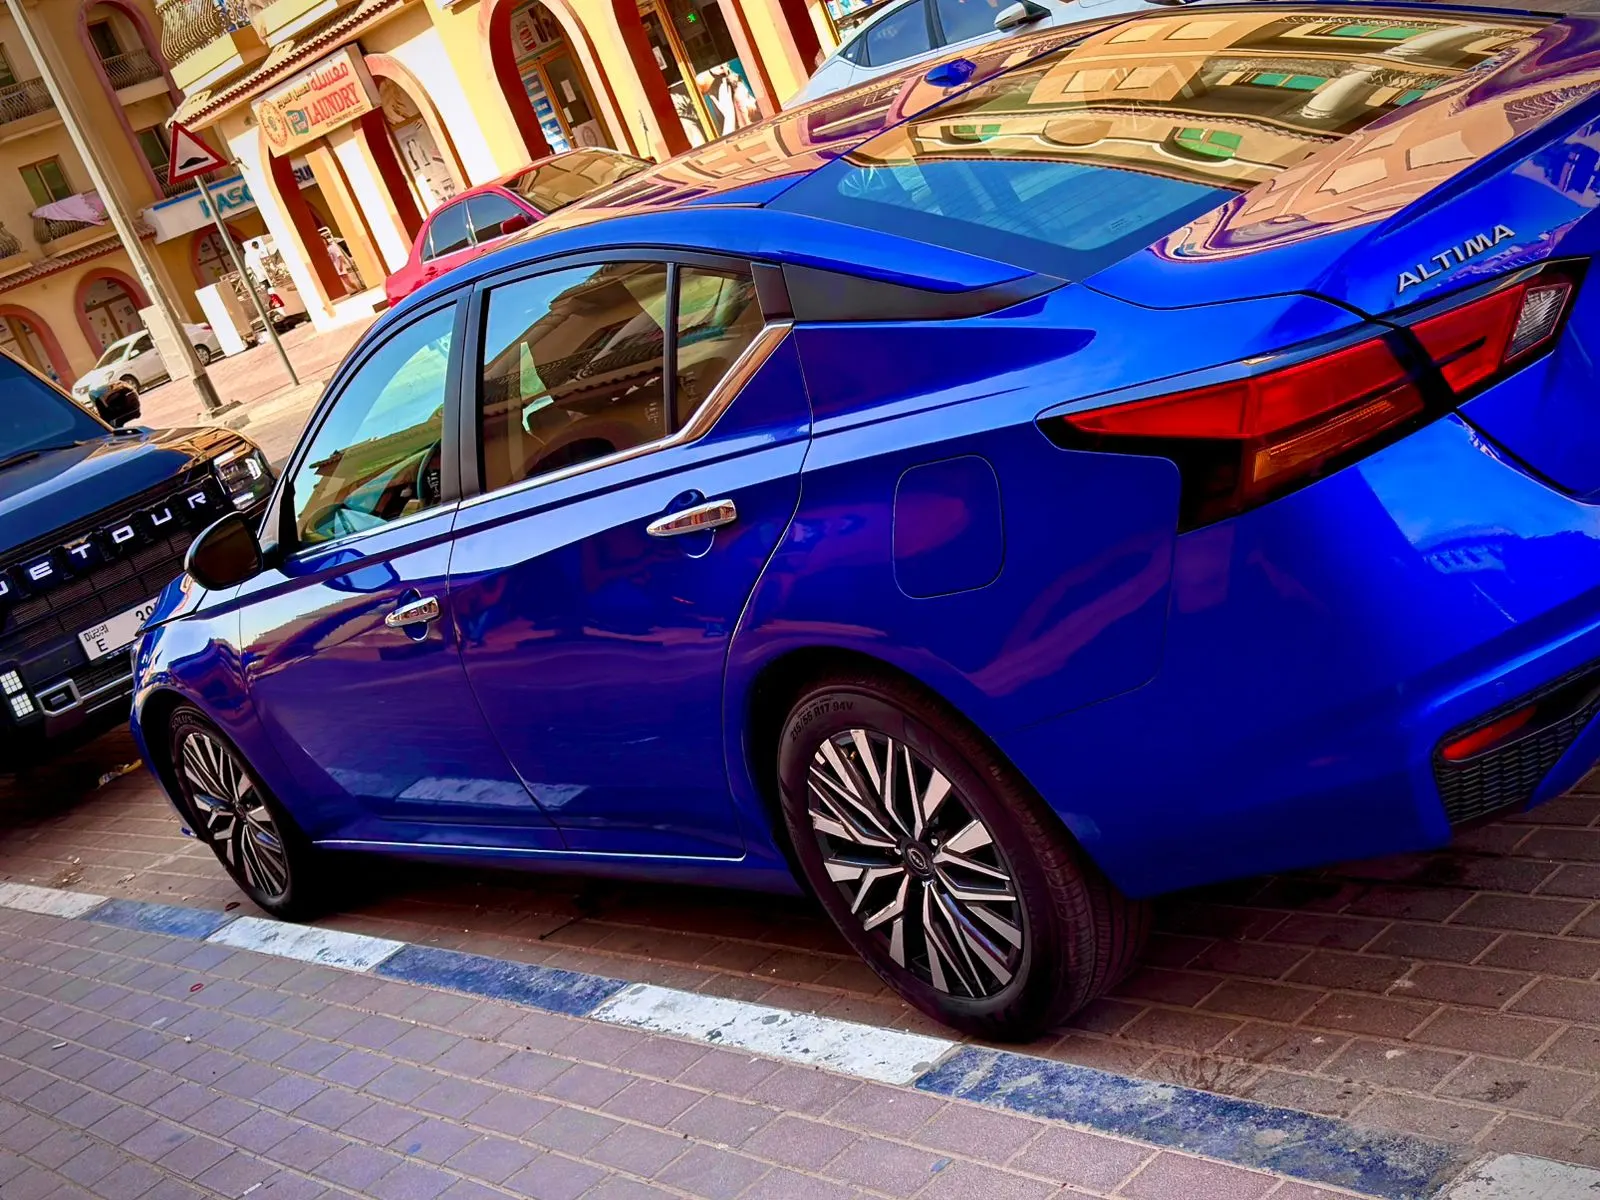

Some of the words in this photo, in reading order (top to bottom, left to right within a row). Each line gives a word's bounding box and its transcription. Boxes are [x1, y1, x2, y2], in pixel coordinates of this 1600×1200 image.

[308, 60, 349, 91] مغسلة
[304, 82, 361, 126] LAUNDRY
[1397, 223, 1516, 293] ALTIMA
[96, 638, 109, 652] E
[813, 703, 830, 717] R17
[833, 700, 854, 711] 94V
